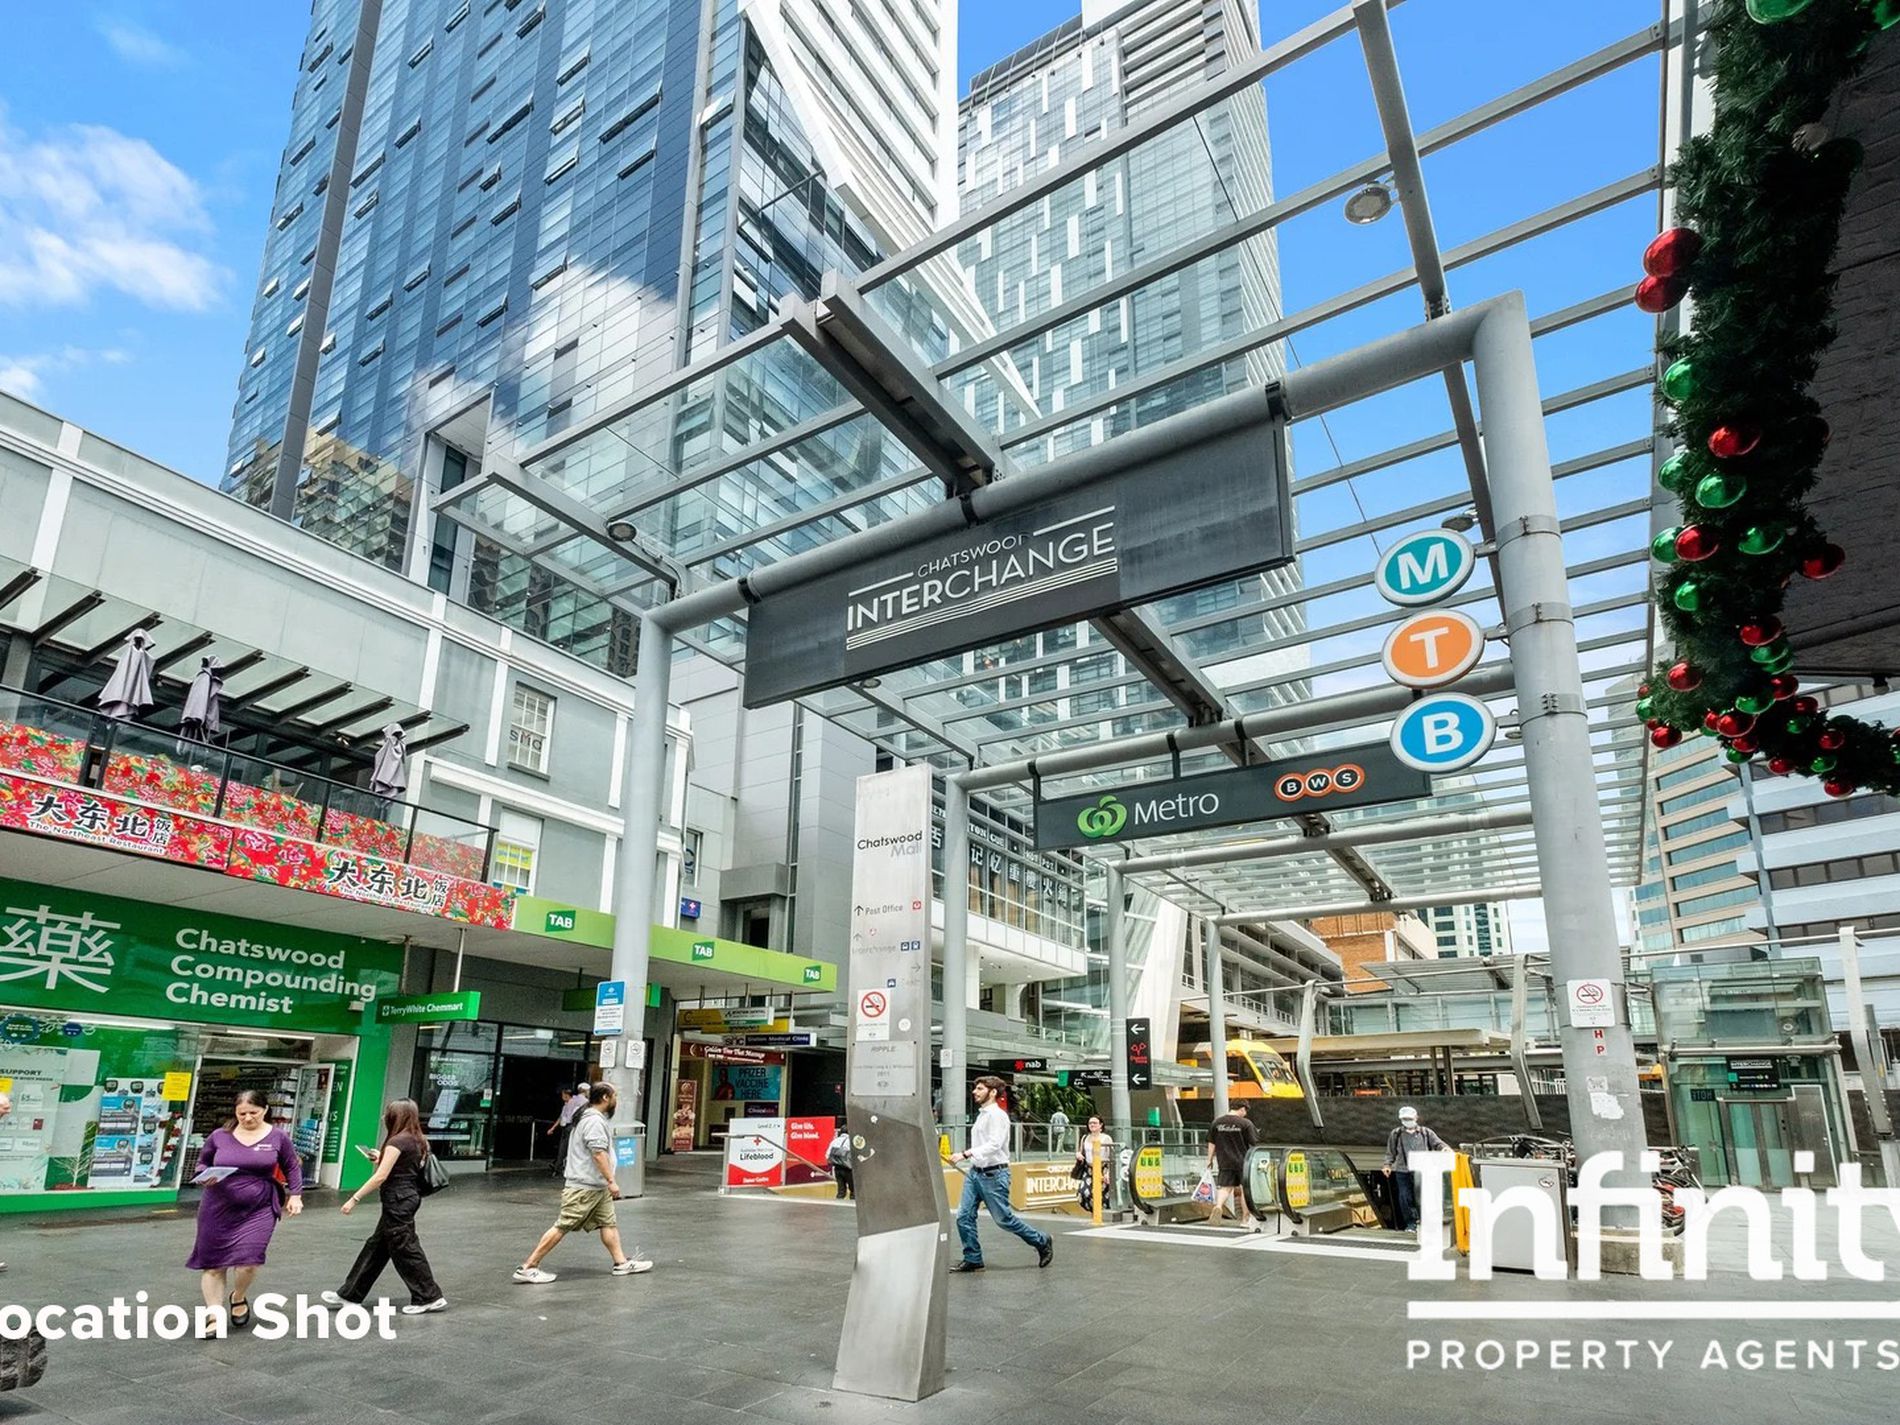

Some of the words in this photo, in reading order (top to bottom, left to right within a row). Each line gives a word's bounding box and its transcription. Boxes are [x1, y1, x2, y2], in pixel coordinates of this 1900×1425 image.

[1397, 541, 1449, 590] M
[847, 522, 1116, 631] INTERCHANGE
[1409, 626, 1449, 669] T
[1422, 711, 1463, 755] B
[29, 796, 148, 837] 大东北
[1134, 793, 1219, 825] Metro
[29, 820, 50, 830] The
[53, 825, 107, 843] Northeast
[109, 836, 164, 854] Restaurant
[857, 830, 923, 850] Chatswood
[328, 860, 428, 900] 大东北
[865, 904, 880, 915] Post
[882, 904, 903, 914] Office
[549, 914, 574, 929] TAB
[0, 905, 121, 993] 藥
[176, 928, 345, 970] Chatswood
[694, 944, 713, 958] TAB
[171, 955, 376, 1001] Compounding
[805, 969, 820, 980] TAB
[165, 982, 293, 1014] Chemist
[390, 1004, 425, 1016] TerryWhite
[427, 1002, 463, 1013] Chemmart
[0, 1068, 42, 1076] SUPPORT
[739, 1067, 766, 1078] PFIZER
[1025, 1060, 1042, 1069] nab
[735, 1078, 769, 1089] VACCINE
[741, 1089, 762, 1099] HERE
[740, 1152, 774, 1161] Lifeblood
[1027, 1175, 1081, 1194] INTERCHA
